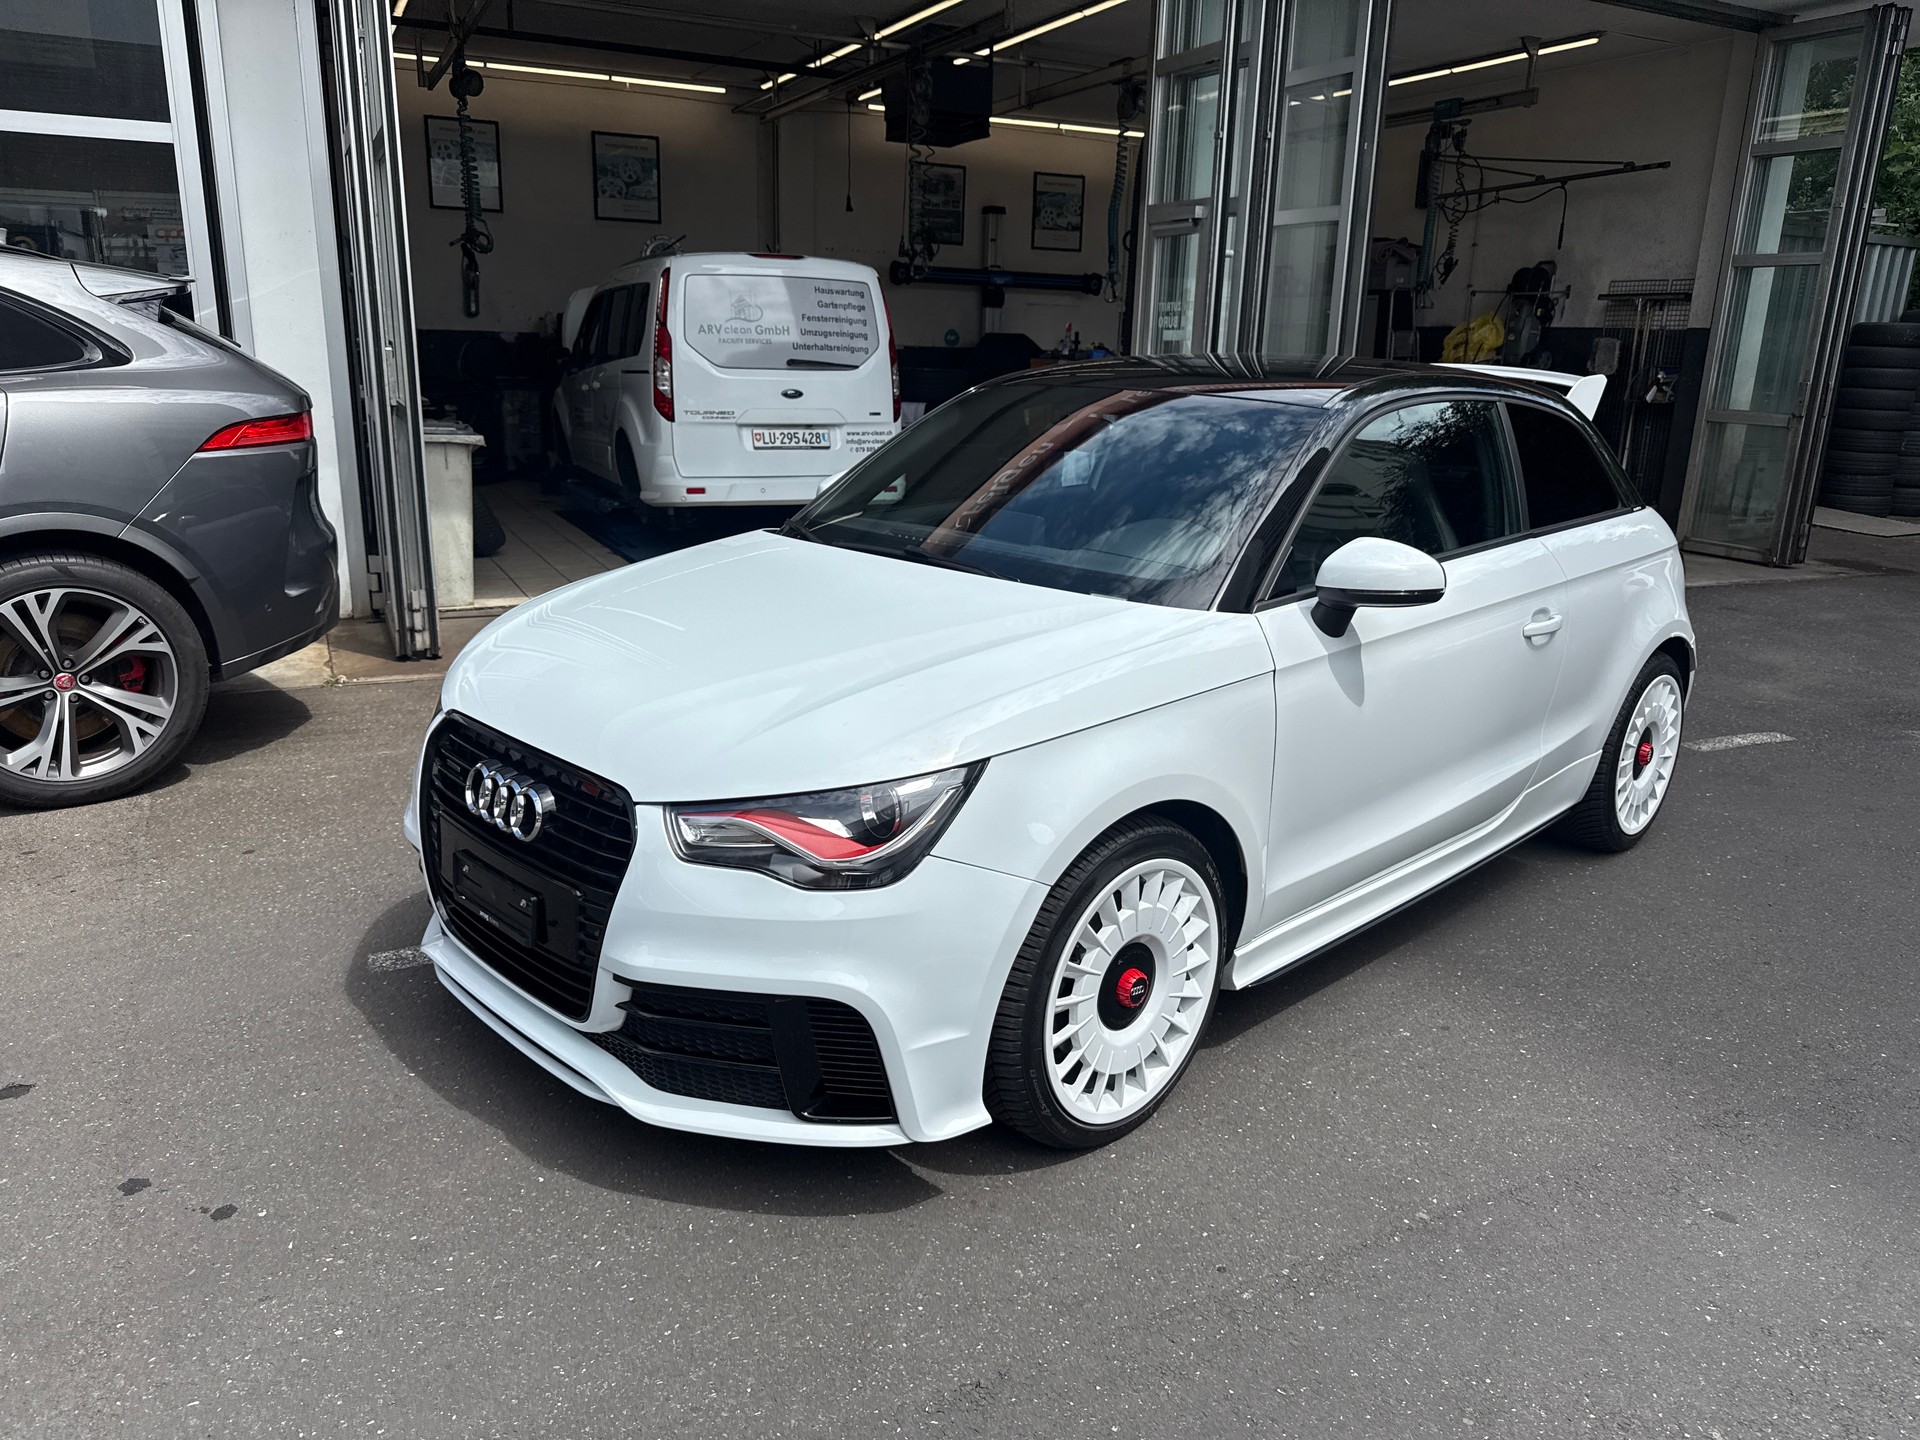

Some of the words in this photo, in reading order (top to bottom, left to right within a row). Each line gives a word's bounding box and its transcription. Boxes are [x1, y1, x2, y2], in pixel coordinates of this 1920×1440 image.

[814, 285, 865, 299] Hauswartung
[817, 300, 866, 312] Gartenpflege
[801, 313, 867, 327] Fensterreinigung
[697, 323, 722, 335] ARV
[724, 324, 752, 335] clean
[754, 324, 790, 336] GmbH
[800, 328, 868, 341] Umzugsreinigung
[744, 337, 773, 345] SERVICES
[792, 342, 869, 355] Unterhaltsreinigung
